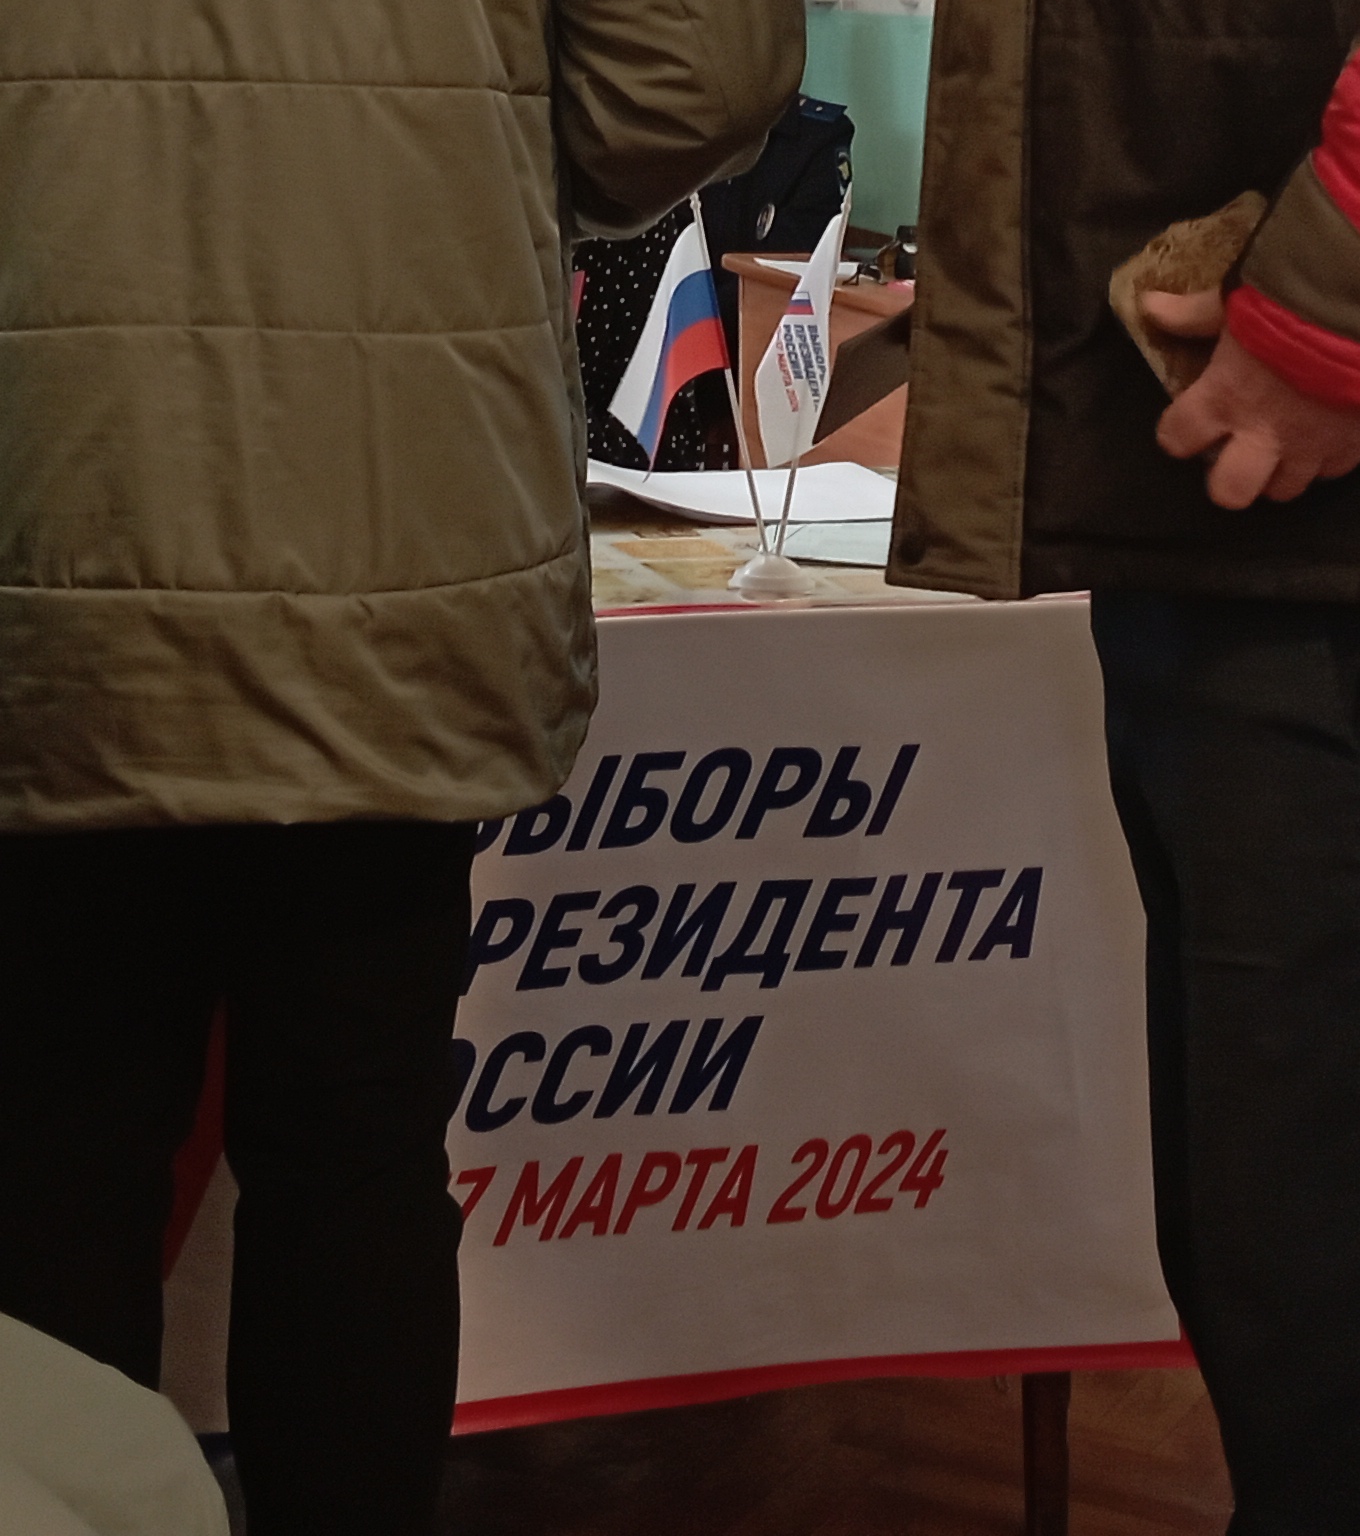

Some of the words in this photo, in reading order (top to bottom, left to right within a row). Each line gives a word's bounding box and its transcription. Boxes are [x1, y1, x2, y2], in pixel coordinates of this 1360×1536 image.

[783, 324, 804, 380] РОССИИ
[474, 743, 921, 857] ЫБОРЫ
[464, 866, 1044, 996] РЕЗИДЕНТА
[451, 1015, 765, 1132] ССИИ
[492, 1145, 759, 1247] МАРТА
[766, 1128, 949, 1224] 2024
